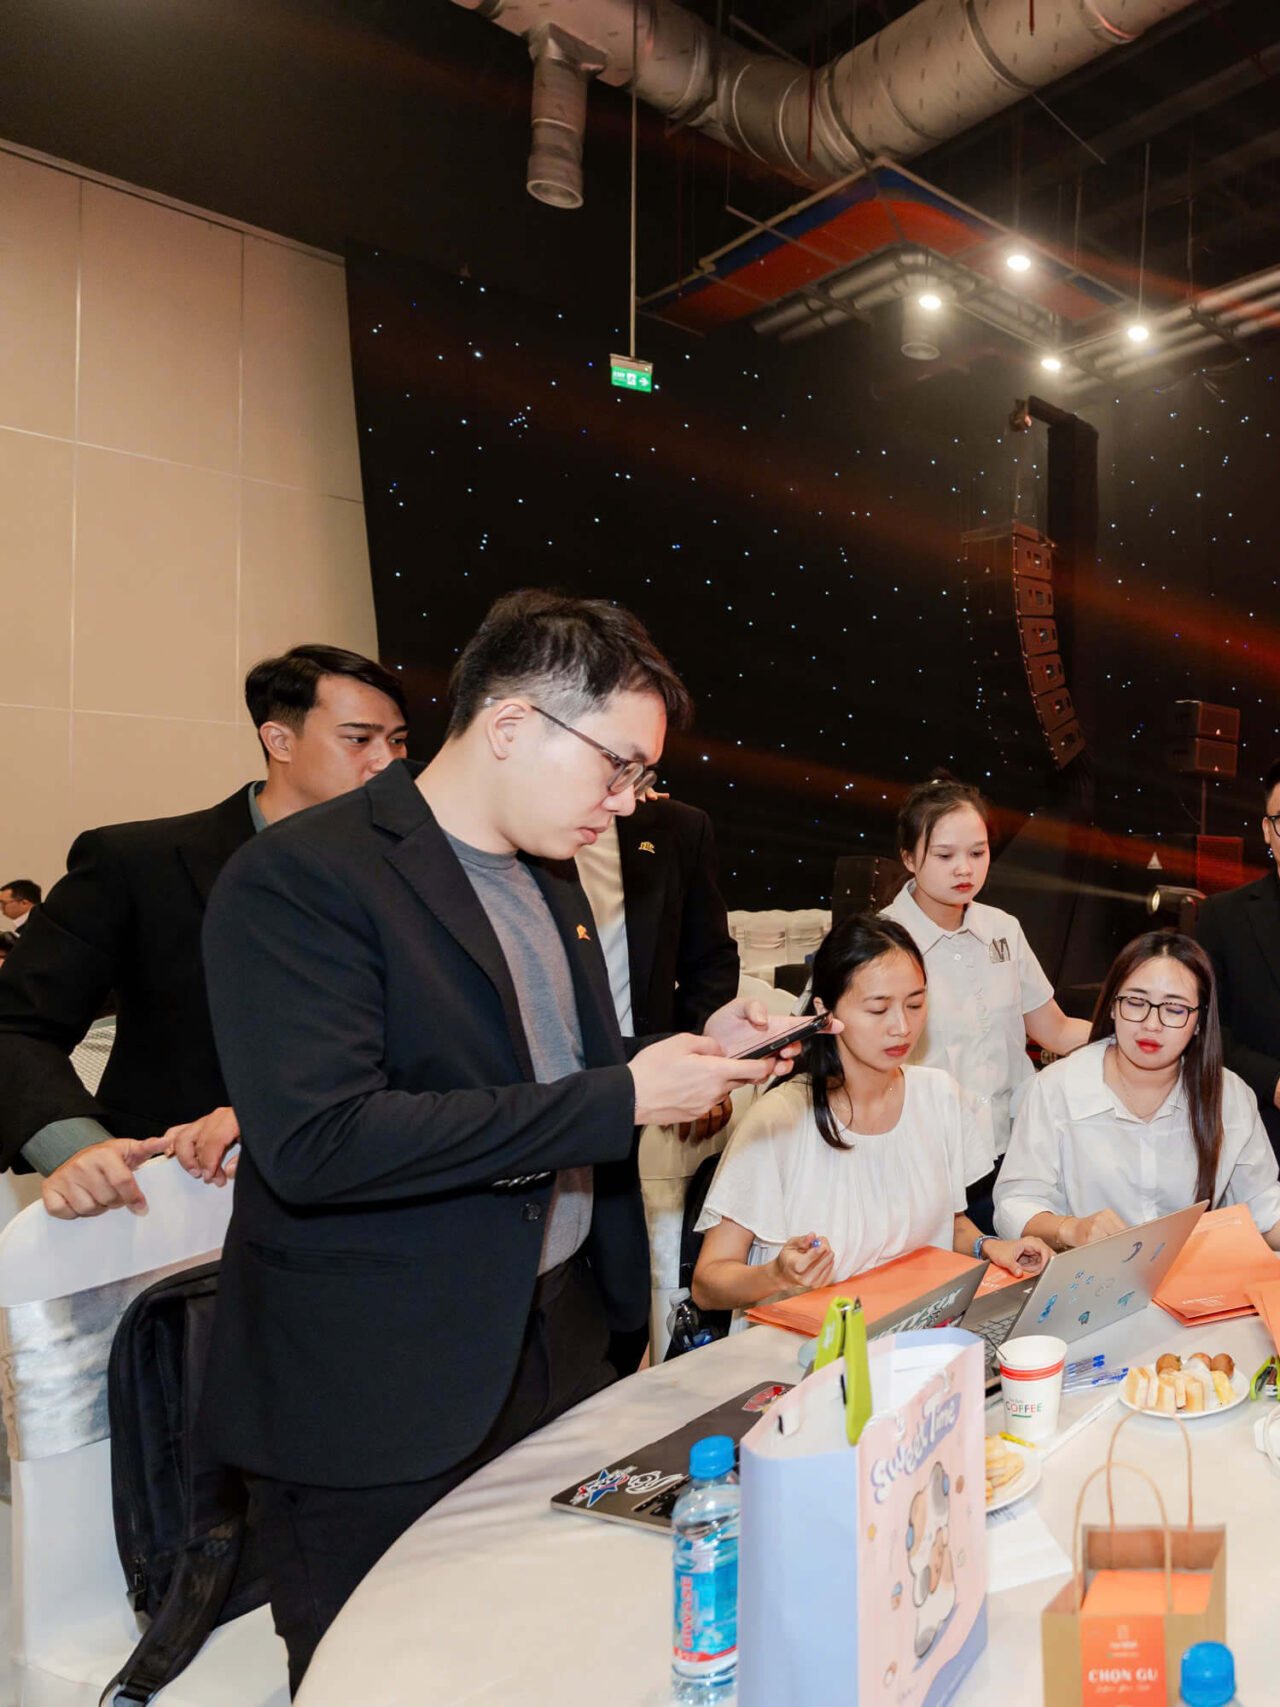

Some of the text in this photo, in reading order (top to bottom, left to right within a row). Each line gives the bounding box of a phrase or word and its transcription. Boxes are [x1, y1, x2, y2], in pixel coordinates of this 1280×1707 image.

[1005, 1400, 1043, 1413] COFFEE
[871, 1391, 956, 1503] Sweet Time
